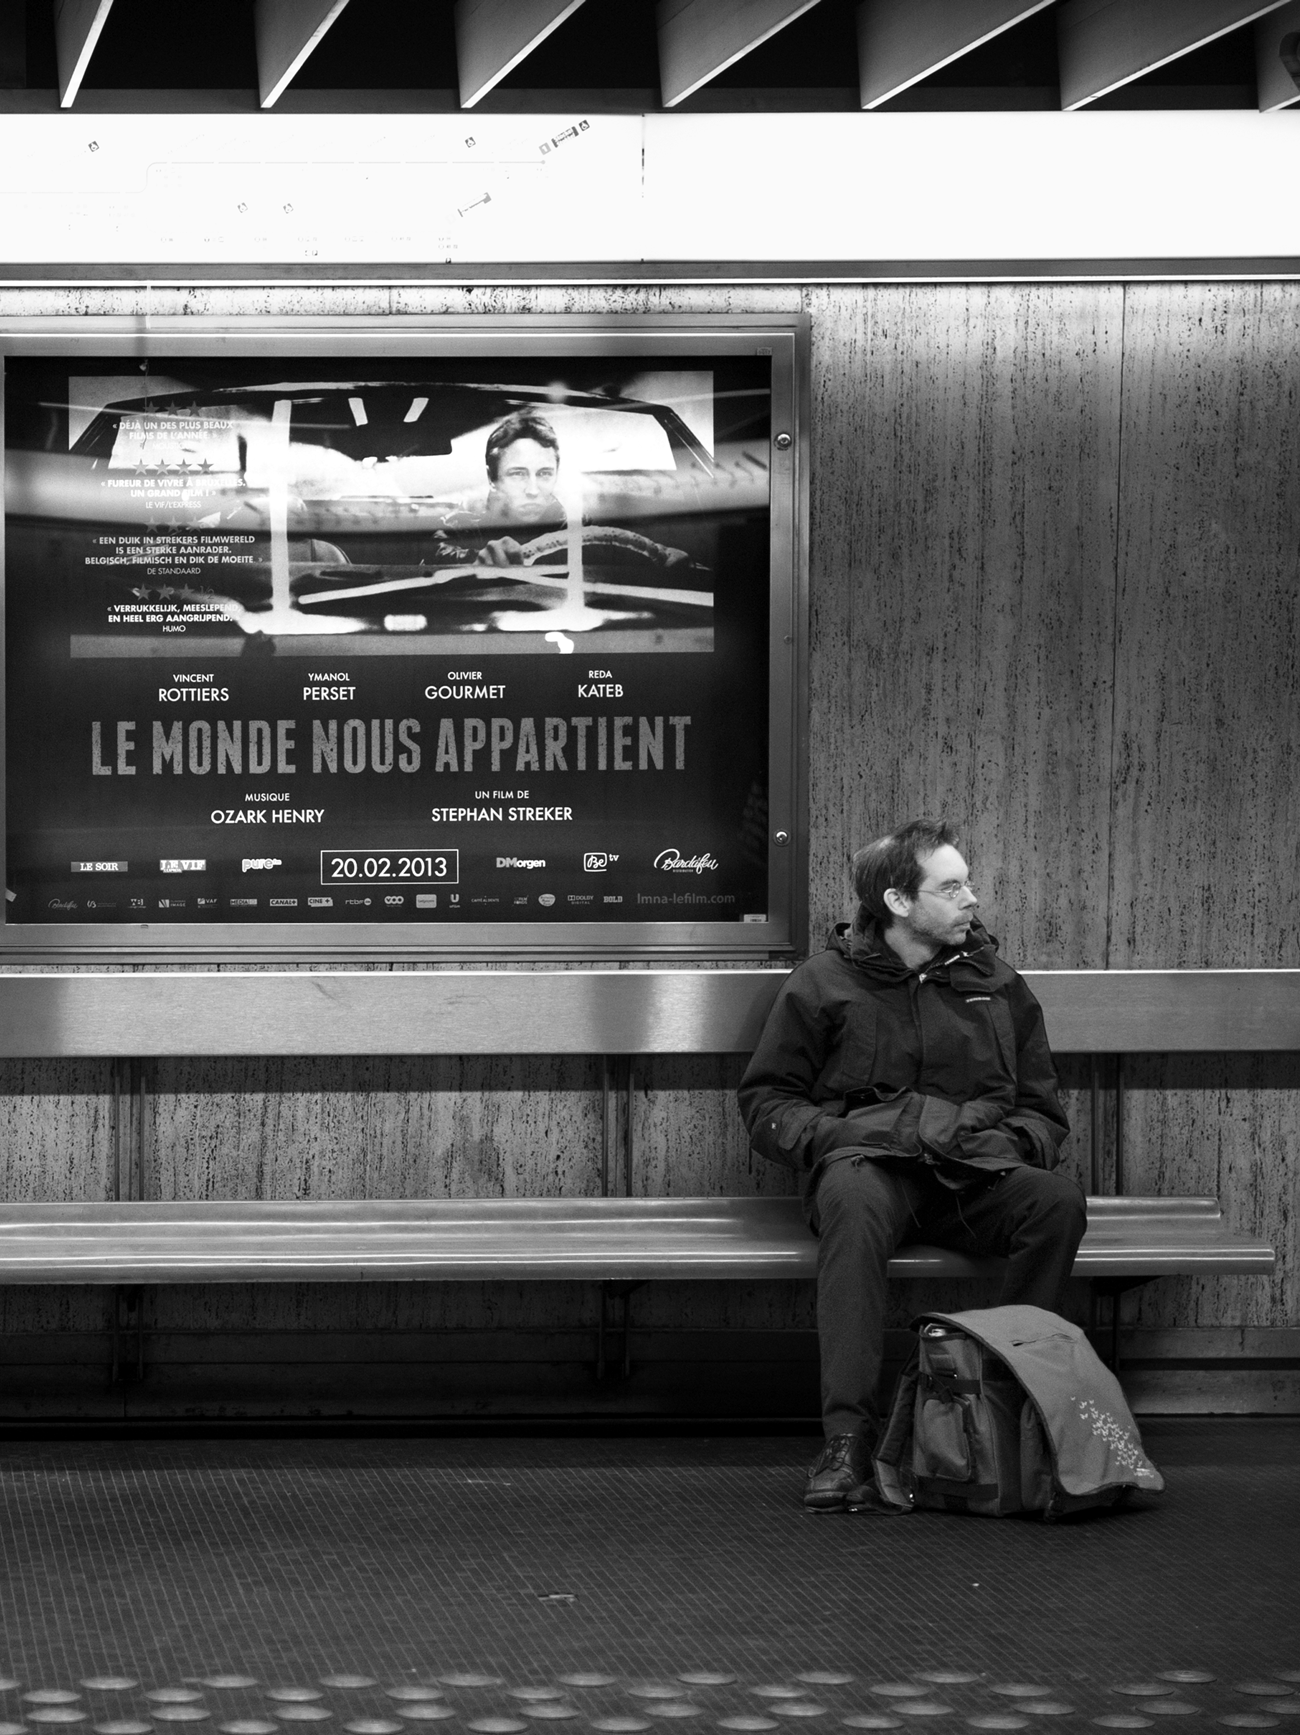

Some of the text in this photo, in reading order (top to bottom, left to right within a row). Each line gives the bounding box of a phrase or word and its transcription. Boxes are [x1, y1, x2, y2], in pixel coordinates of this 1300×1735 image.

[119, 419, 142, 431] DÉJÀ
[144, 421, 158, 430] UN
[160, 421, 177, 430] DES
[179, 421, 201, 430] PLUS
[203, 421, 234, 429] BEAUX
[155, 431, 168, 439] DE
[108, 479, 142, 488] FUREUR
[144, 479, 156, 487] DE
[157, 479, 184, 487] VIVRE
[187, 476, 194, 487] À
[147, 489, 181, 497] GRAND
[118, 536, 141, 544] DUIK
[143, 536, 154, 544] IN
[156, 536, 198, 544] STREKERS
[116, 546, 232, 554] IS EEN STERKE AANRADER.
[85, 556, 130, 565] BELGISCH,
[132, 556, 172, 564] FILMISCH
[174, 556, 187, 564] EN
[189, 556, 204, 564] DIK
[158, 567, 201, 575] STANDAARD
[114, 604, 181, 614] VERRUKKELIJK,
[108, 614, 233, 623] EN HEEL ERG AANGRIJPEND.
[162, 624, 186, 633] HUMO
[173, 674, 214, 683] VINCENT
[308, 673, 350, 682] YMANOL
[447, 671, 482, 681] OLIVIER
[588, 670, 612, 679] REDA
[158, 688, 229, 702] ROTTIERS
[303, 687, 356, 701] PERSET
[424, 685, 506, 700] GOURMET
[578, 684, 624, 698] KATEB
[92, 716, 692, 776] LE MONDE NOUS APPARTIENT
[245, 793, 290, 803] MUSIQUE
[475, 790, 529, 800] UN FILM DE
[210, 809, 325, 824] OZARK HENRY
[431, 807, 573, 822] STEPHAN STREKER
[80, 862, 119, 871] LE SOIR
[180, 859, 206, 871] VIF
[587, 854, 620, 869] Be tv
[331, 857, 447, 878] 20.02.2013
[637, 893, 736, 904] lmna-lefilm.com
